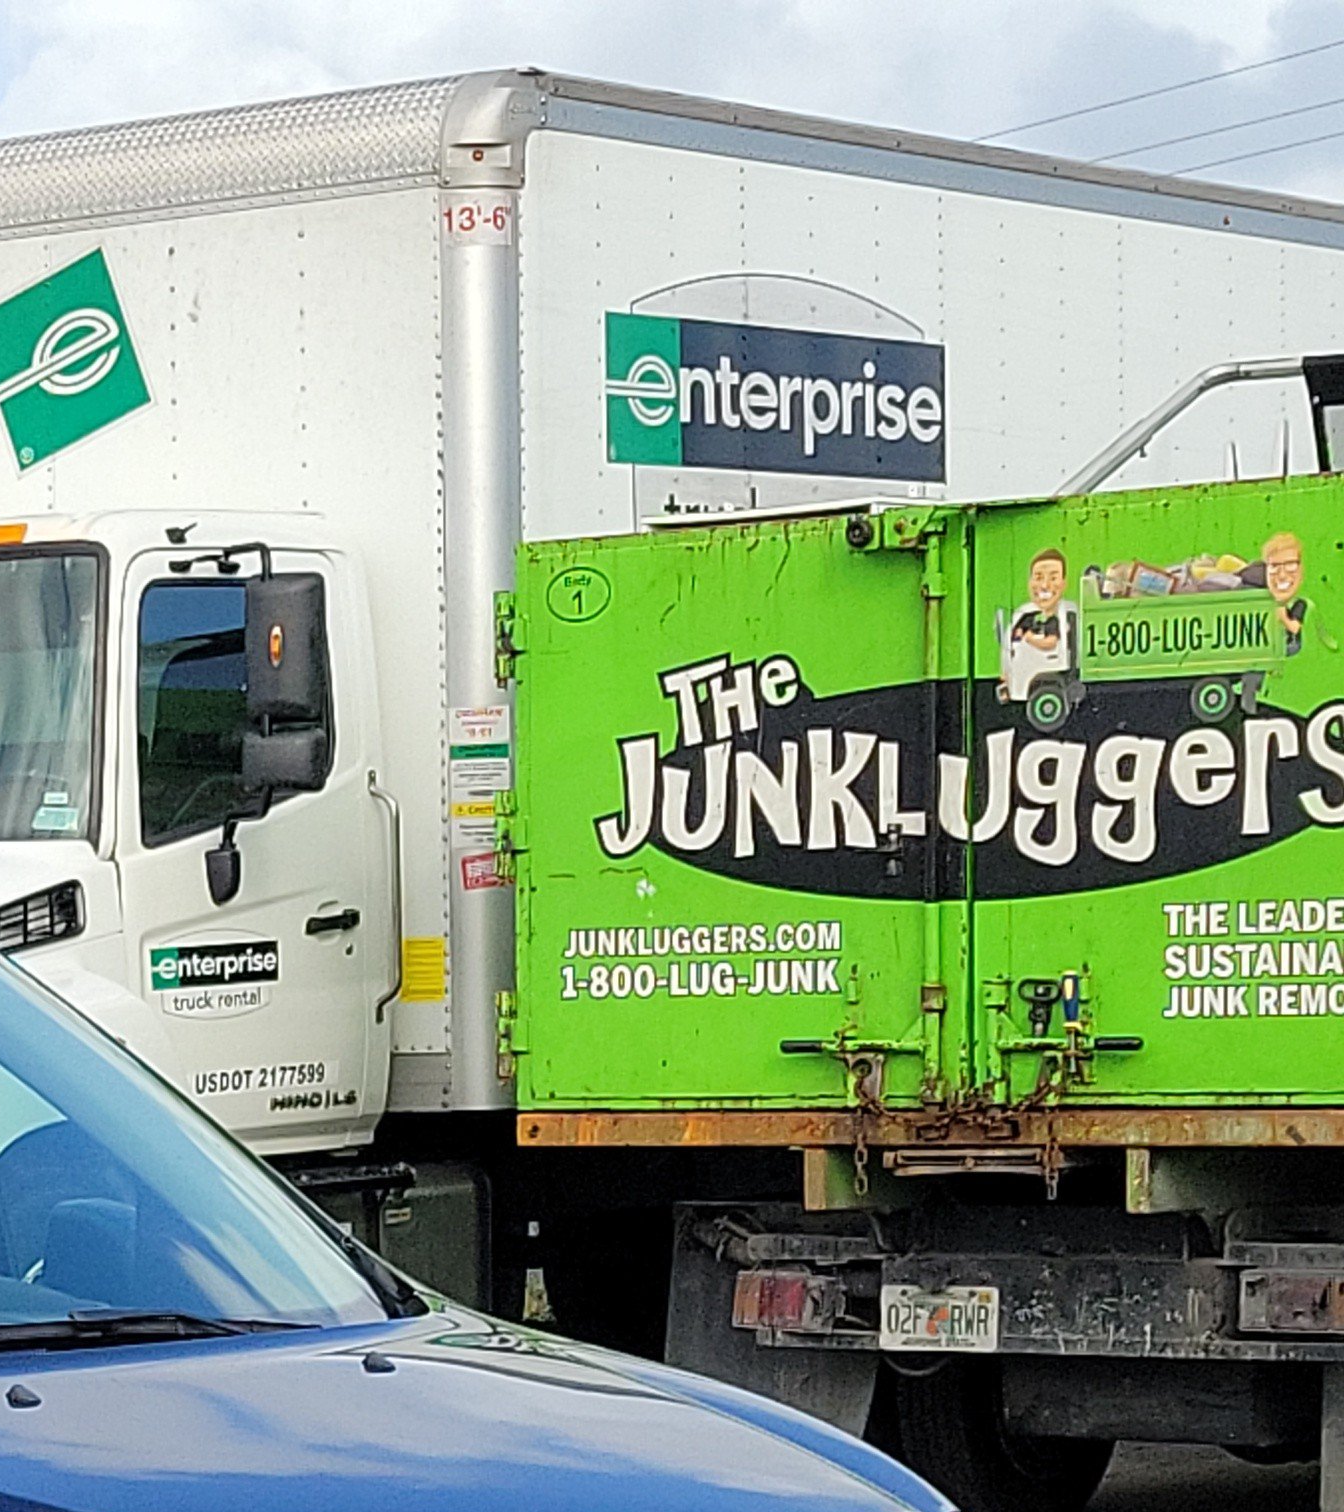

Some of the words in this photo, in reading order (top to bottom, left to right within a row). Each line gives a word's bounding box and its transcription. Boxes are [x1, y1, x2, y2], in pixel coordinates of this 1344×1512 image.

[605, 354, 942, 456] enterprise
[1087, 611, 1270, 657] 1-800-LUG-JUNK
[1163, 902, 1229, 937] THE
[563, 921, 841, 958] JUNKLUGGERS.COM
[151, 947, 277, 981] enterprise
[561, 958, 841, 999] 1-800-LUG-JUNK
[172, 990, 214, 1012] truck
[218, 986, 262, 1009] rental
[1163, 985, 1249, 1019] JUNK
[195, 1069, 254, 1095] USDOT
[258, 1061, 326, 1089] 2177599
